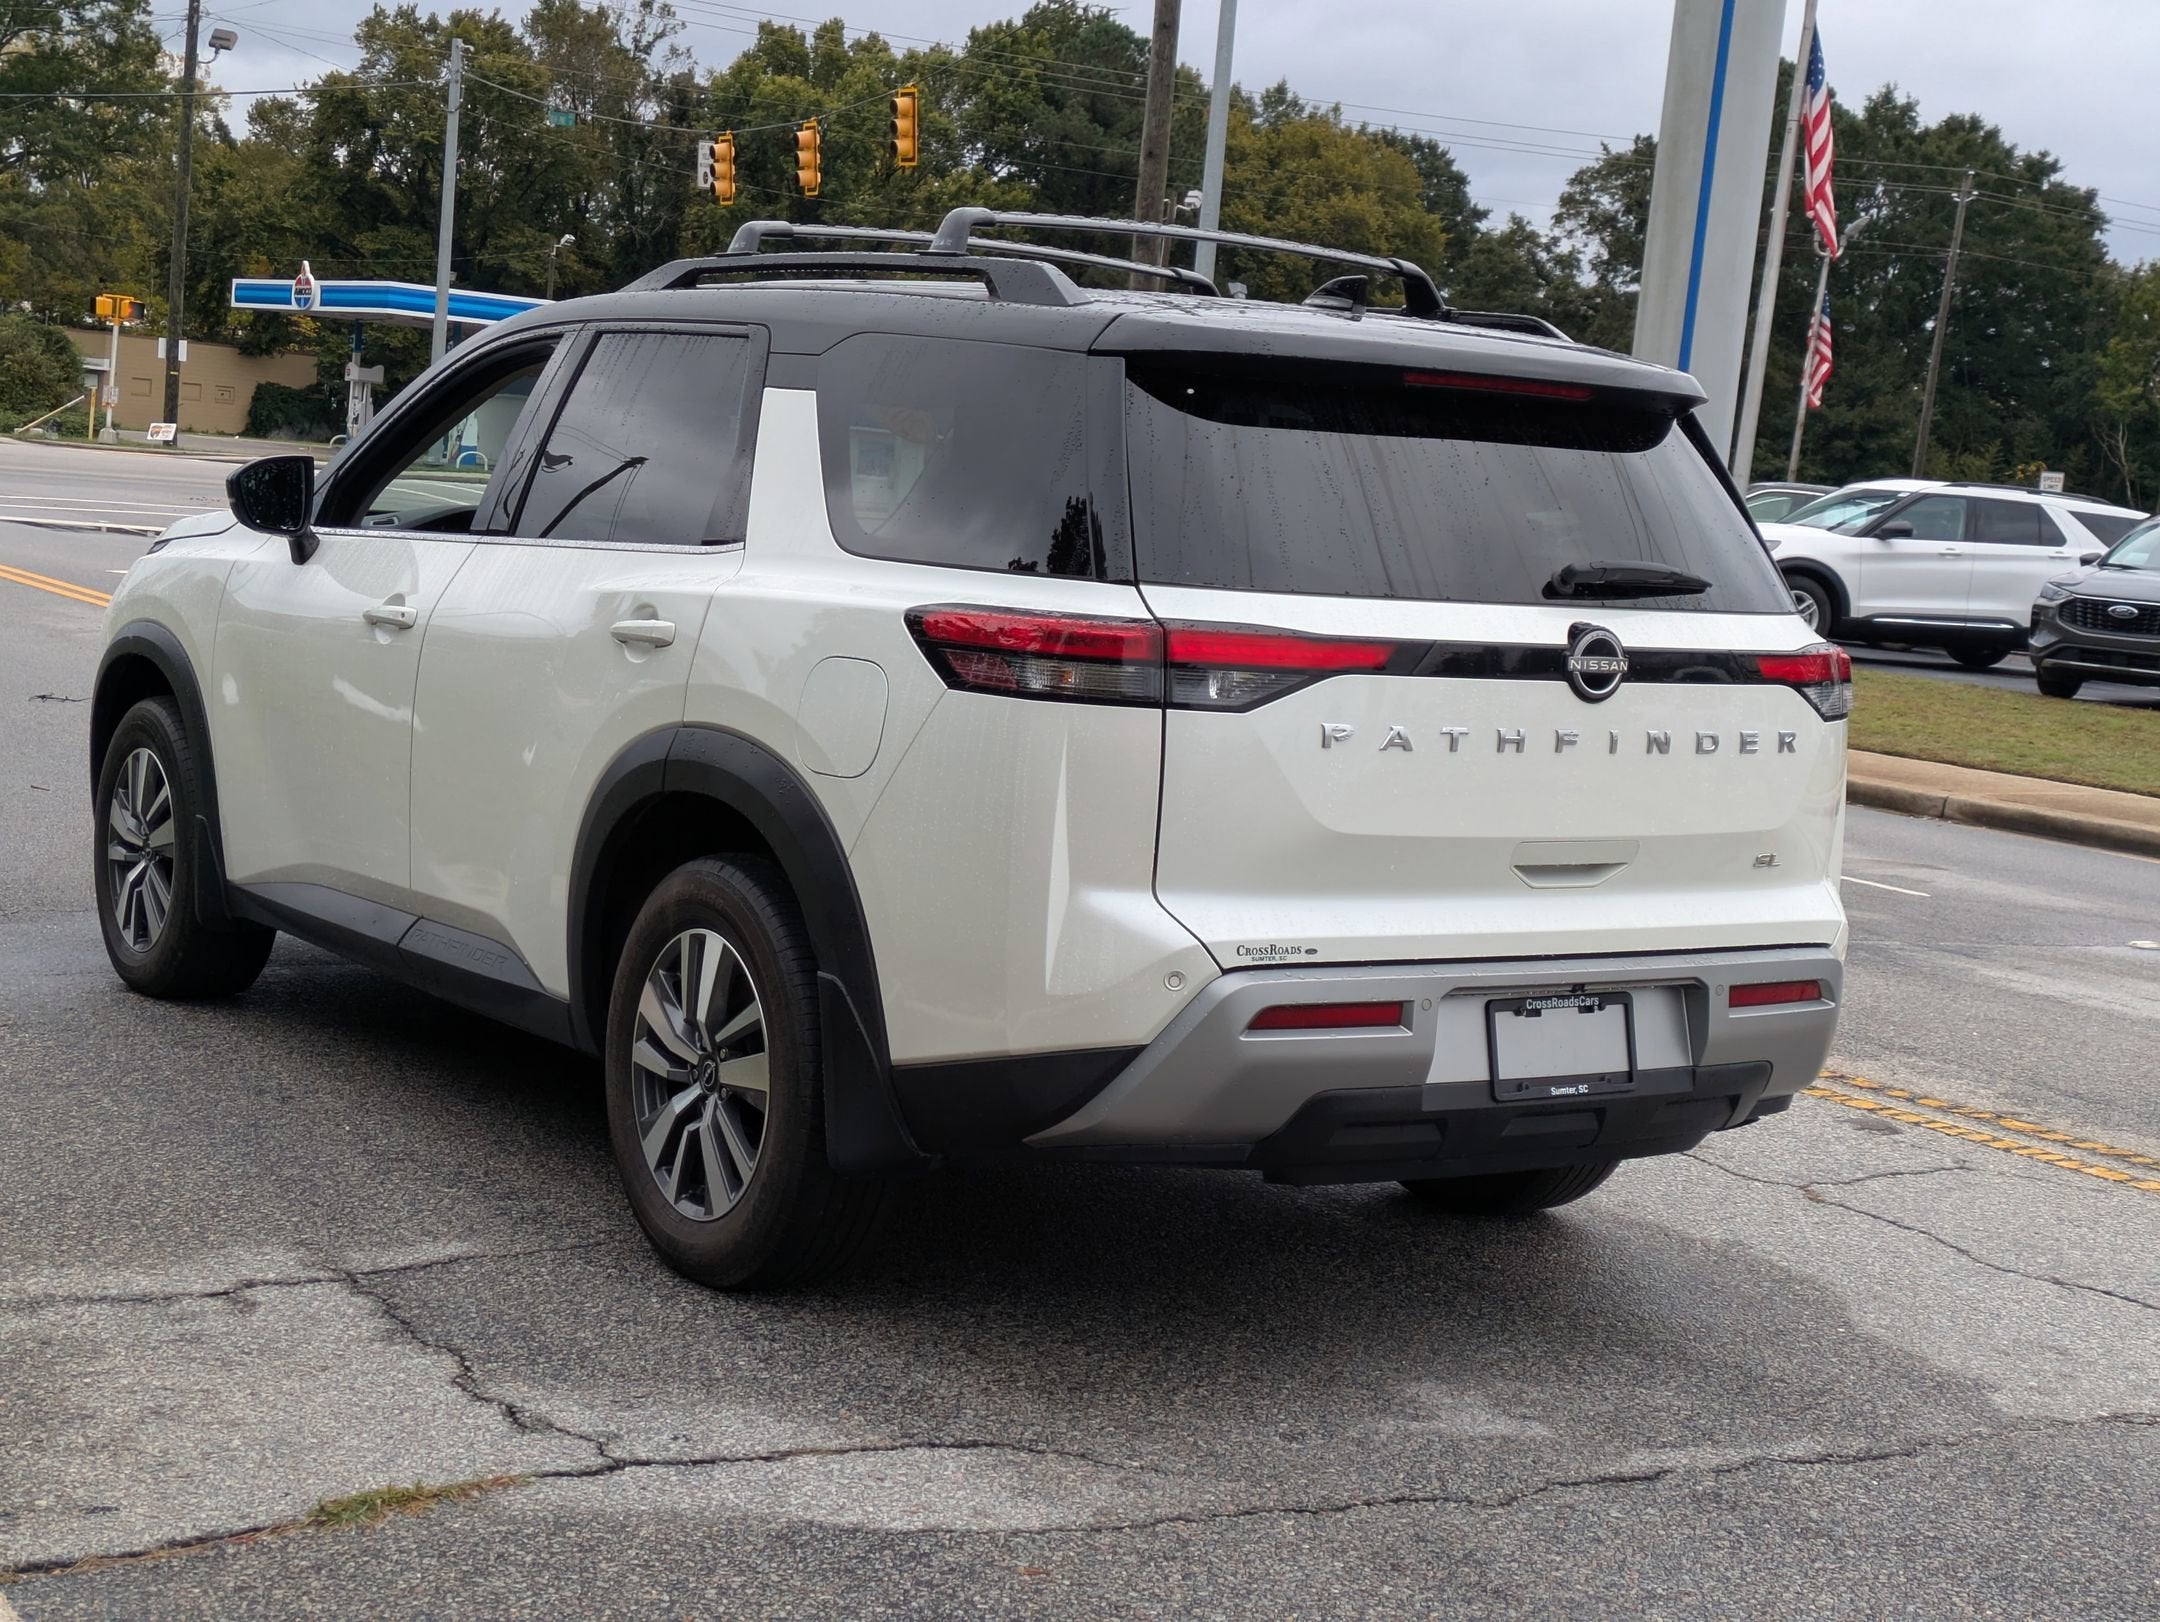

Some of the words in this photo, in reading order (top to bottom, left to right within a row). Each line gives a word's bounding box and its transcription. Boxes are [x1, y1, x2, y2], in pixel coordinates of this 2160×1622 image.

[1570, 659, 1628, 671] NISSAN
[1321, 722, 1798, 755] PATHFINDER
[1526, 996, 1599, 1009] CrossRoadsCars
[1551, 1085, 1577, 1096] Sumter,
[1579, 1084, 1589, 1094] SC
